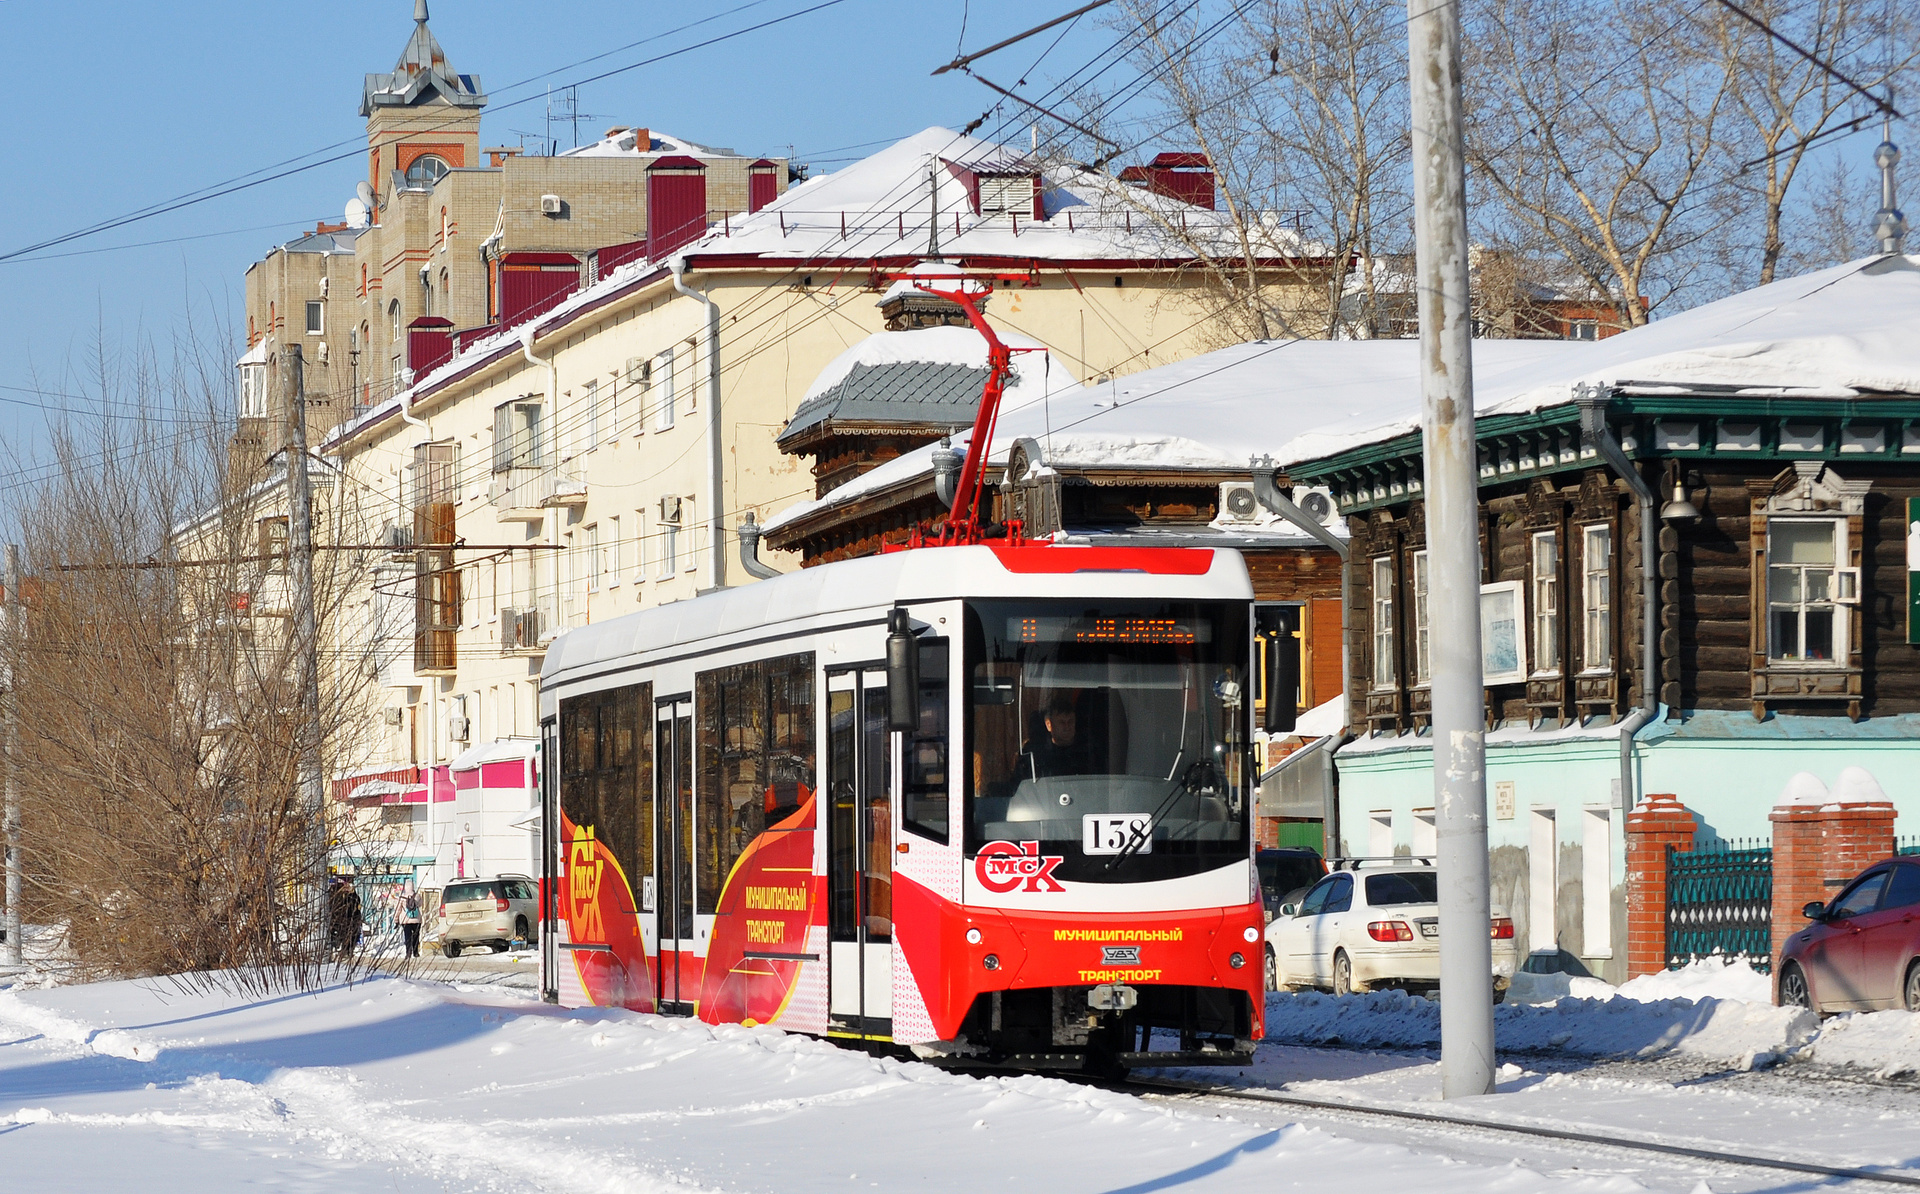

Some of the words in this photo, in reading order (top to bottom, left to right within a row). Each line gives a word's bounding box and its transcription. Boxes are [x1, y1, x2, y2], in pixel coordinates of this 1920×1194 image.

[1091, 819, 1146, 849] 138
[746, 880, 807, 911] МУНИЦИПАЛЬНЫЙ
[746, 920, 785, 944] ТРАНСПОРТ
[1053, 927, 1183, 941] МУНИЦИПАЛЬНЫЙ
[1078, 970, 1162, 981] ТРАНСПОРТ
